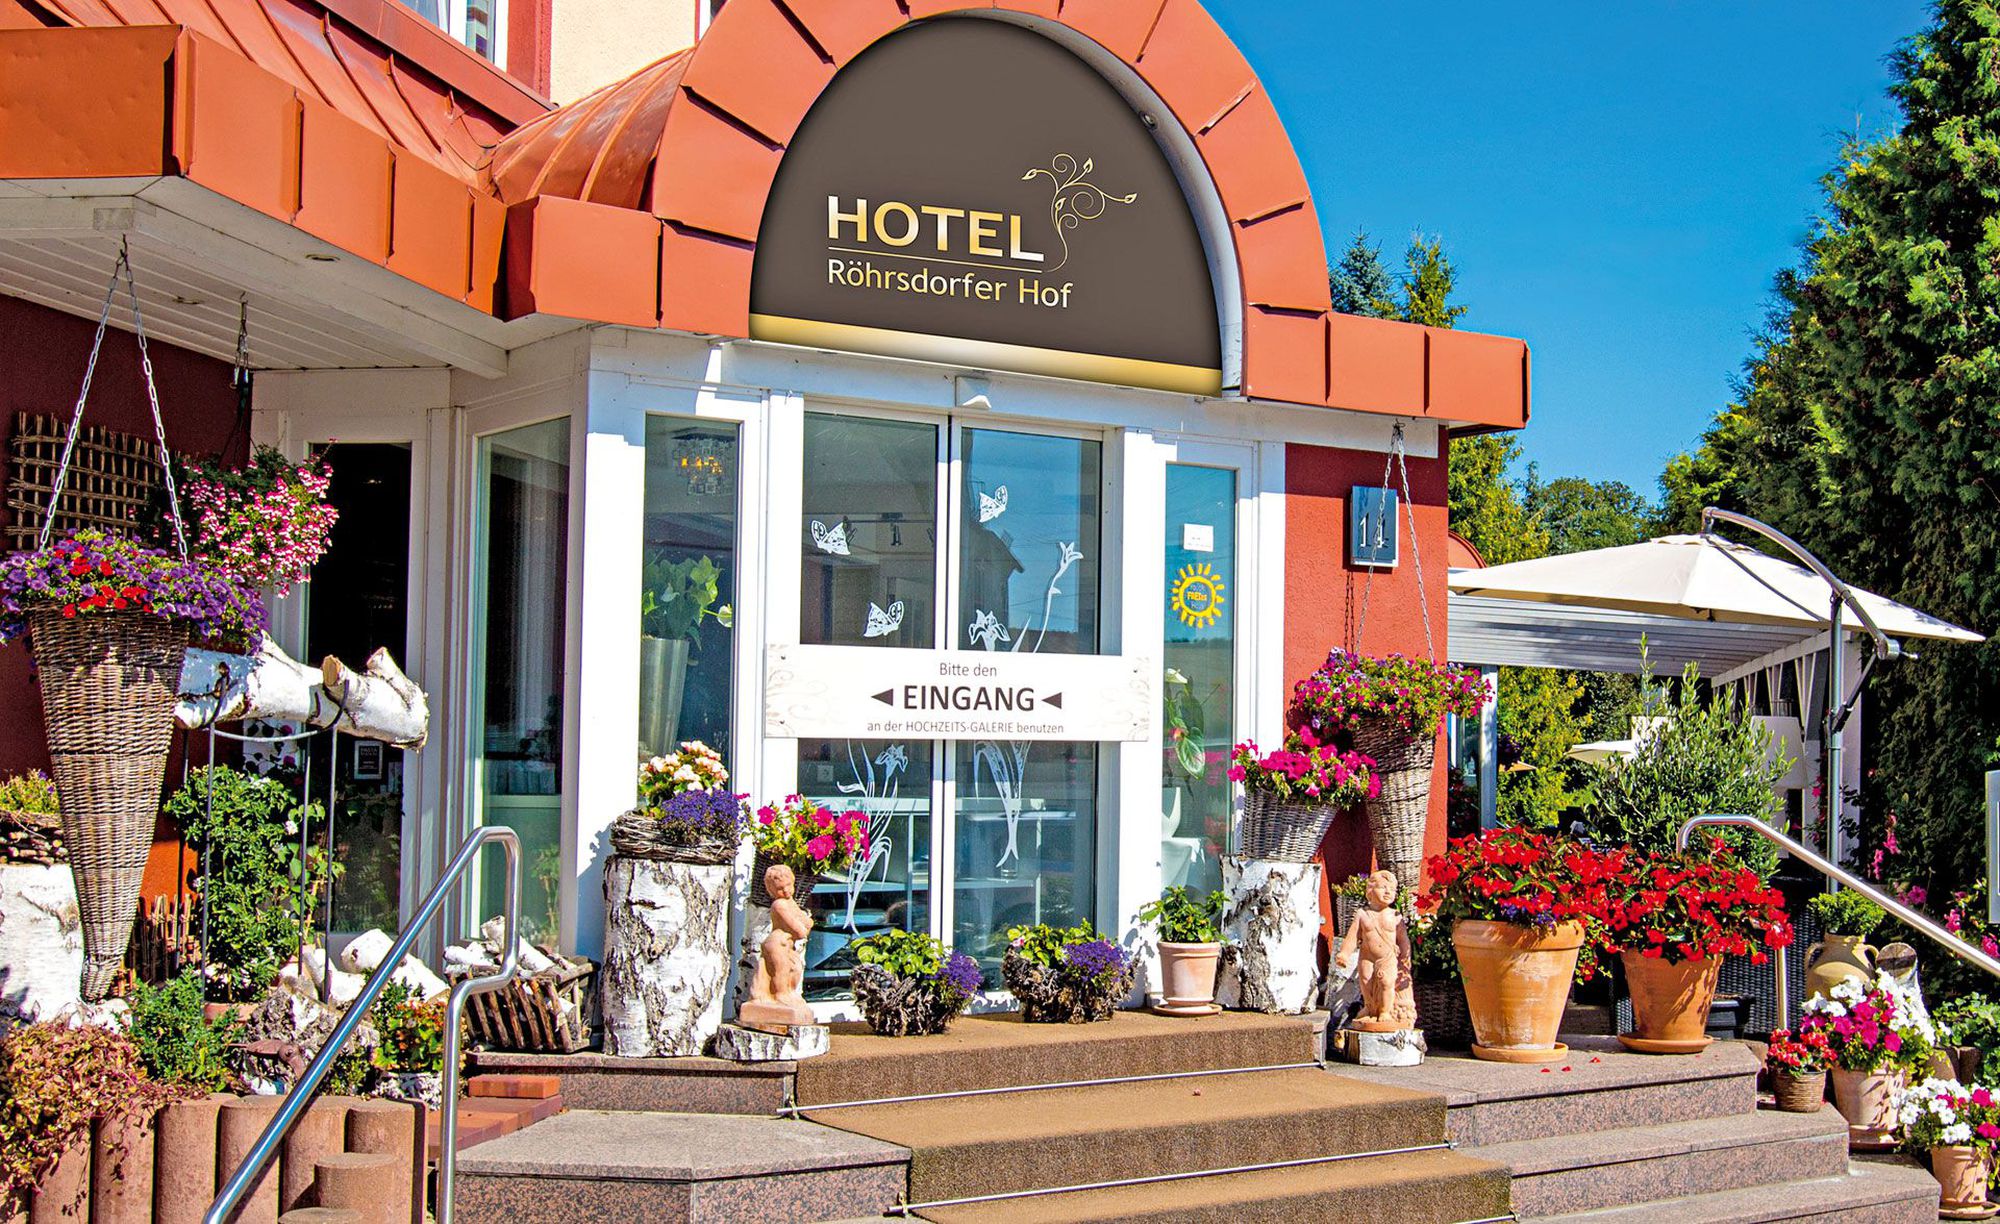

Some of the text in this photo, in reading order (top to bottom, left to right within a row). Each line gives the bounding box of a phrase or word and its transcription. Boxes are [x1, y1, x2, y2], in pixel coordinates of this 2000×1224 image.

[828, 196, 1044, 262] HOTEL
[828, 259, 1074, 308] Röhrsdorfer Hof
[940, 662, 997, 677] Bitte den
[904, 685, 1035, 711] EINGANG
[867, 721, 1064, 734] an der HOCHZEITS-GALERIE benutzen
